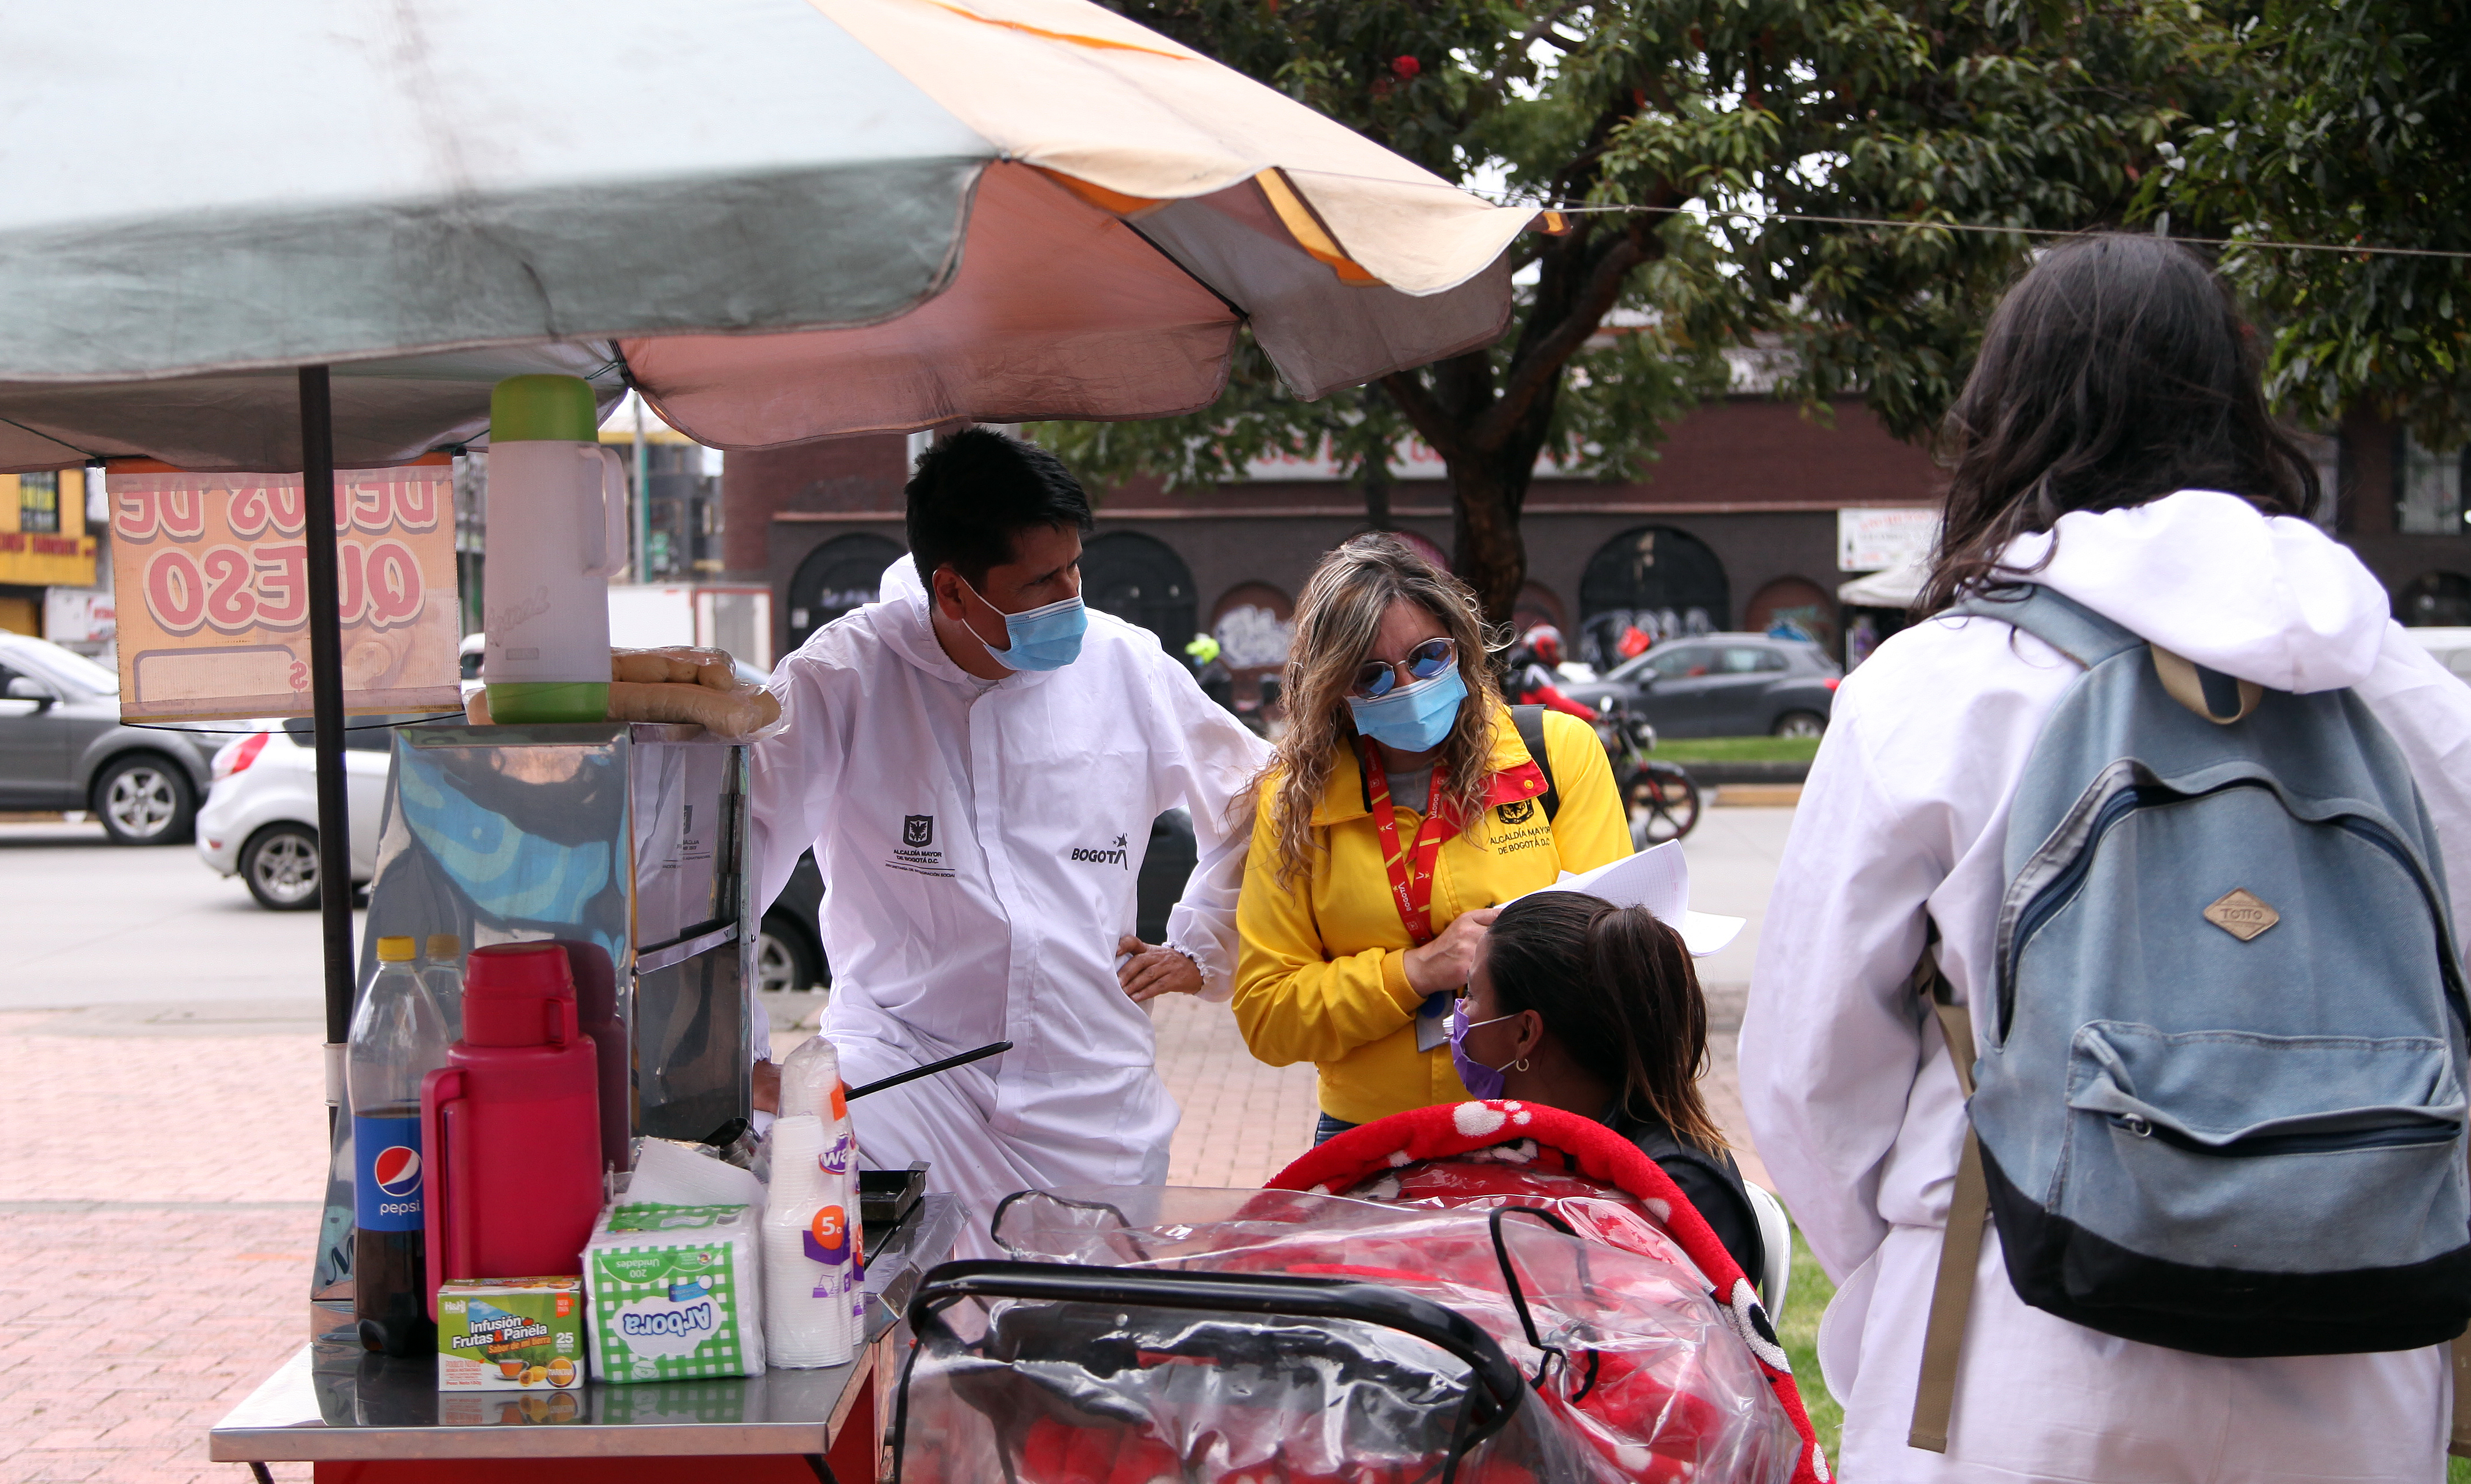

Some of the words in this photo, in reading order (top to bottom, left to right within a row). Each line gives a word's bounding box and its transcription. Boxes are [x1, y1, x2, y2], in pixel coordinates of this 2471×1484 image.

[1490, 828, 1527, 844] ALCALDÍA
[1498, 847, 1508, 855] DE
[1509, 836, 1540, 852] BOGOTÁ
[2220, 908, 2263, 920] TOTTO
[380, 1199, 420, 1215] pepsi
[616, 1259, 660, 1269] Unidades
[630, 1269, 647, 1278] 200
[470, 1315, 522, 1334] Infusión
[623, 1302, 711, 1336] Arbora
[452, 1334, 494, 1349] Frutas
[504, 1323, 548, 1341] Panela
[556, 1332, 574, 1344] 25
